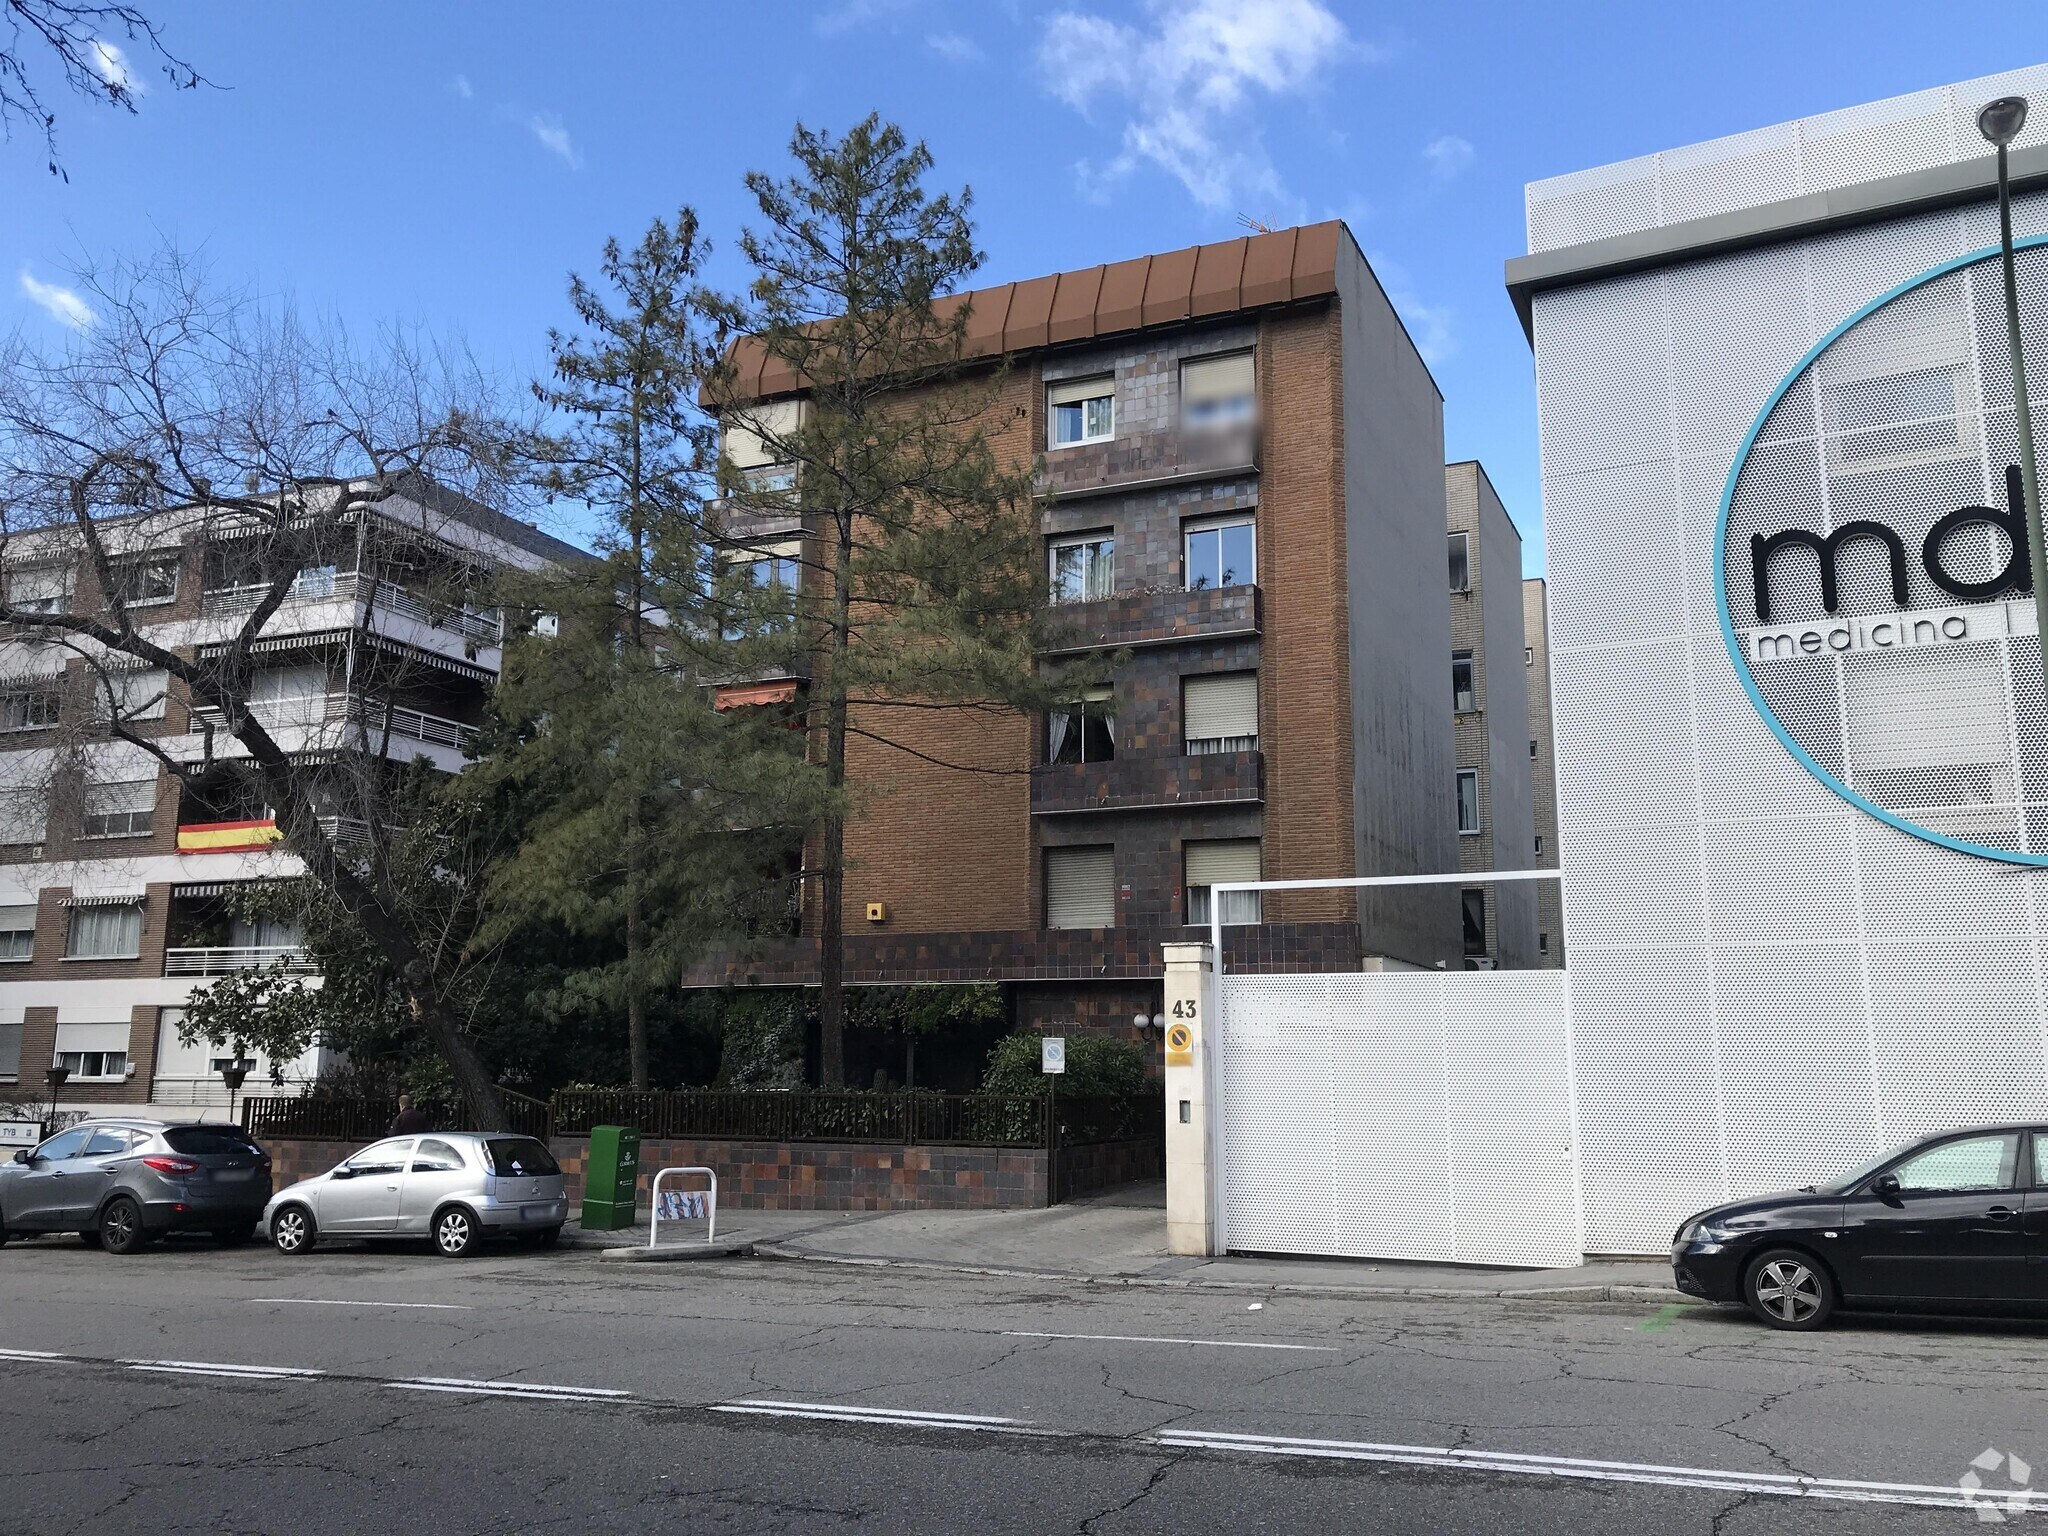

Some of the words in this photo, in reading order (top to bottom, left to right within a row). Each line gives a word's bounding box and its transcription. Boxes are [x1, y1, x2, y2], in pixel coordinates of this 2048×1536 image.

[1750, 464, 2034, 621] md
[1757, 615, 1968, 659] medicina
[1172, 999, 1197, 1019] 43
